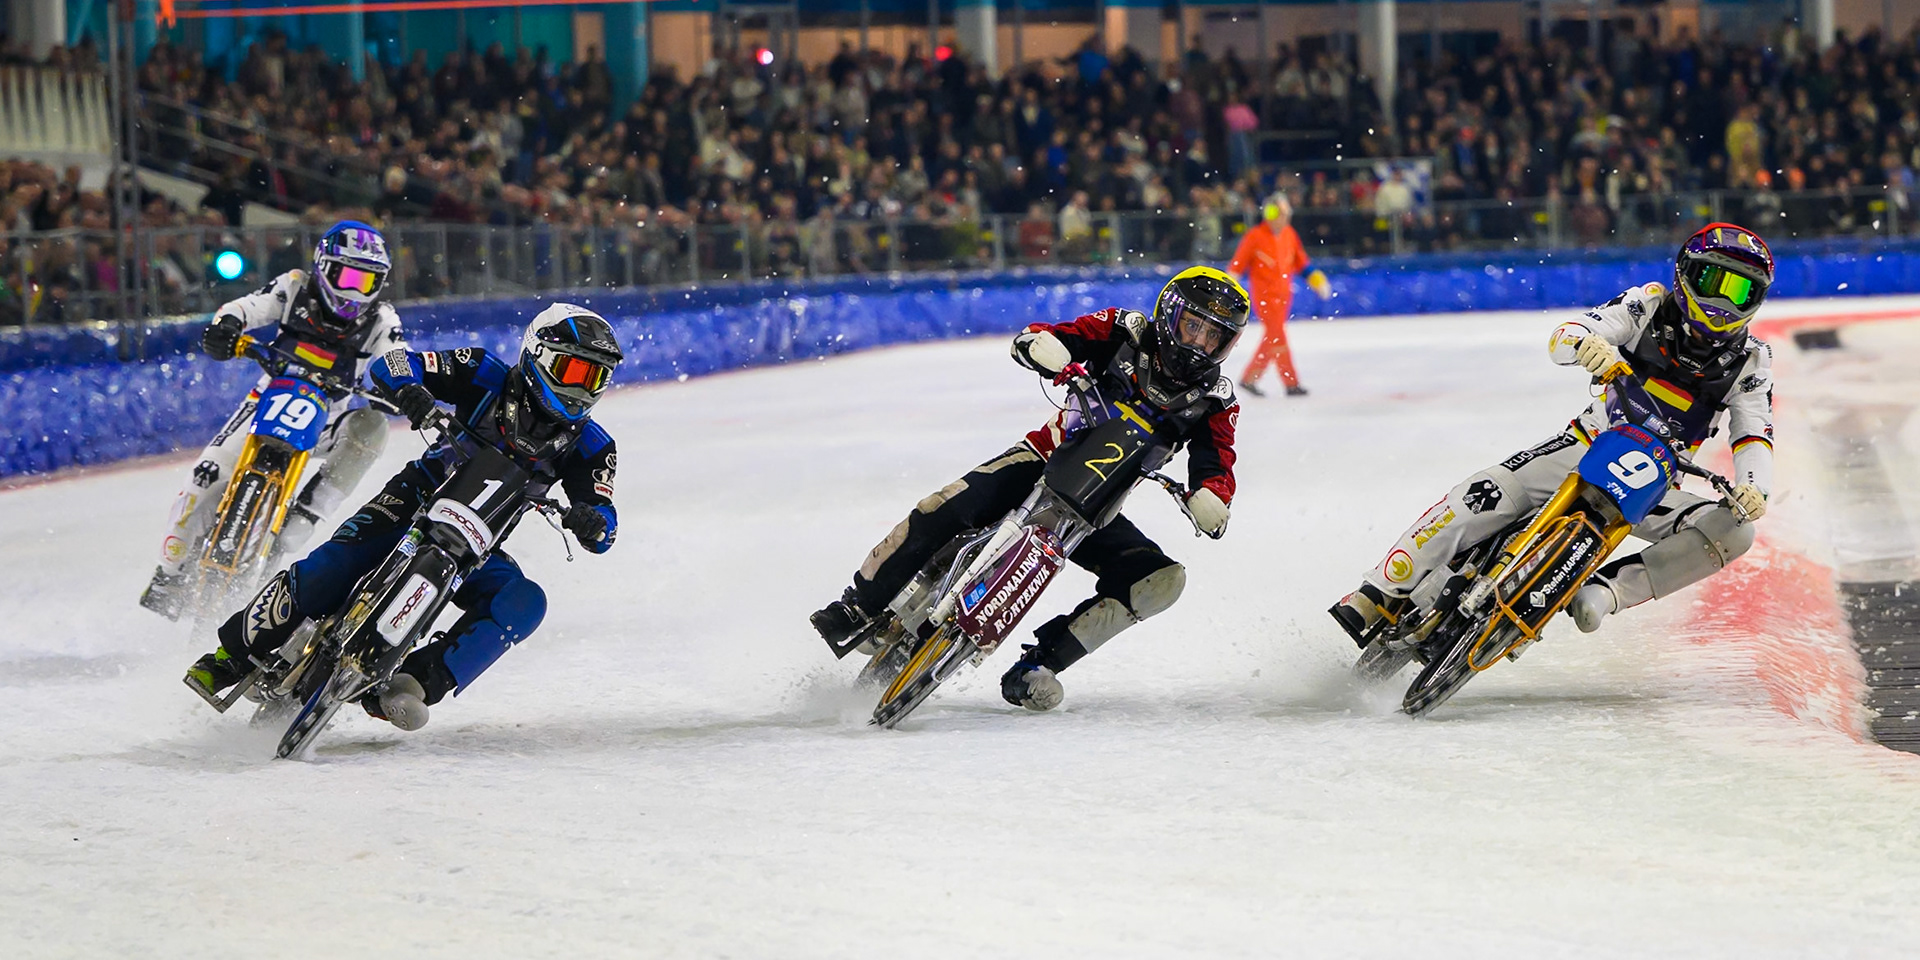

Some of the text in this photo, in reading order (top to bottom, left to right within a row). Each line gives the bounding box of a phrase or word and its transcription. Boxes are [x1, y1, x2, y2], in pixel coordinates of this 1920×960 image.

[263, 393, 317, 430] 19
[1084, 443, 1124, 481] 2
[1607, 451, 1660, 490] 9
[469, 479, 503, 511] 1
[1609, 481, 1628, 500] FIM
[975, 547, 1042, 626] NORDMALINGS
[994, 564, 1050, 634] RÖRTEKNIK
[1543, 571, 1566, 595] Stefan
